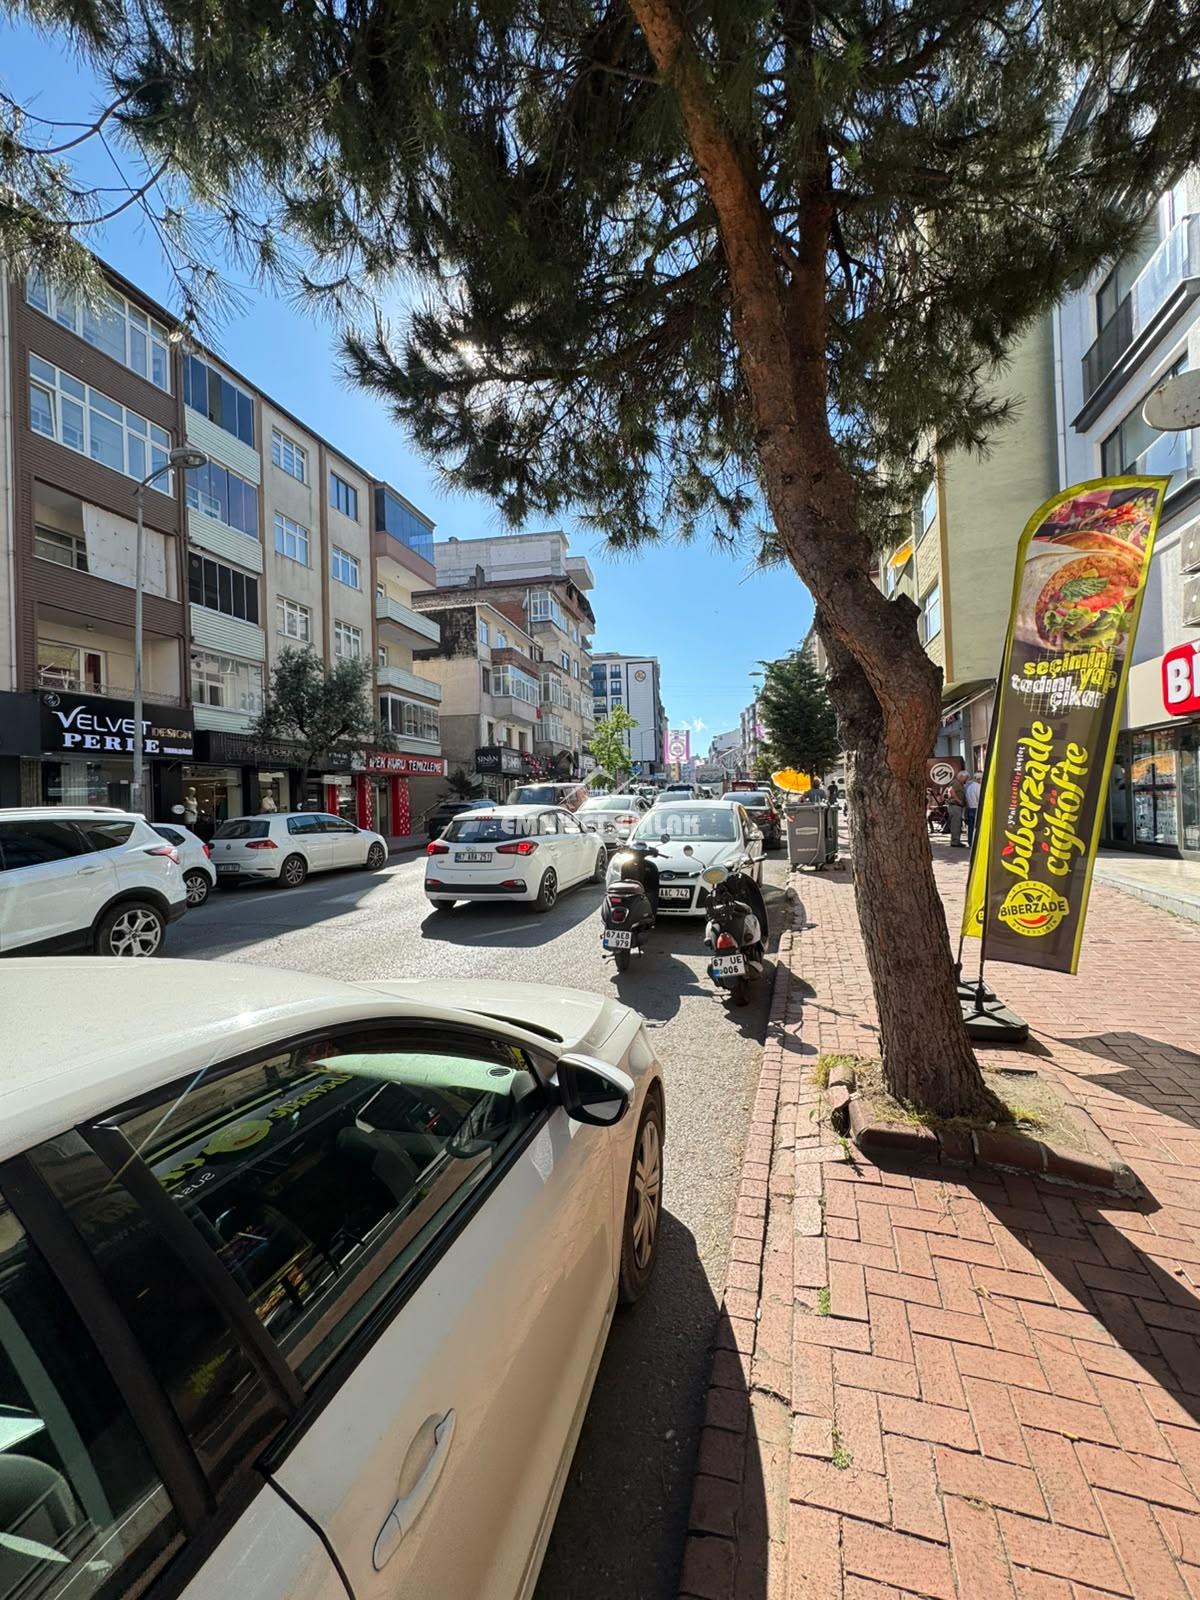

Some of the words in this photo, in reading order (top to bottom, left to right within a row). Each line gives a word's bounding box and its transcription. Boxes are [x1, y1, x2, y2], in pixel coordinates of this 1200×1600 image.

[1023, 647, 1116, 679] seçimini
[1011, 673, 1073, 693] tadını
[1079, 667, 1118, 694] yap
[1050, 686, 1105, 712] çıkar
[52, 705, 152, 736] VELVET
[730, 955, 743, 965] UE
